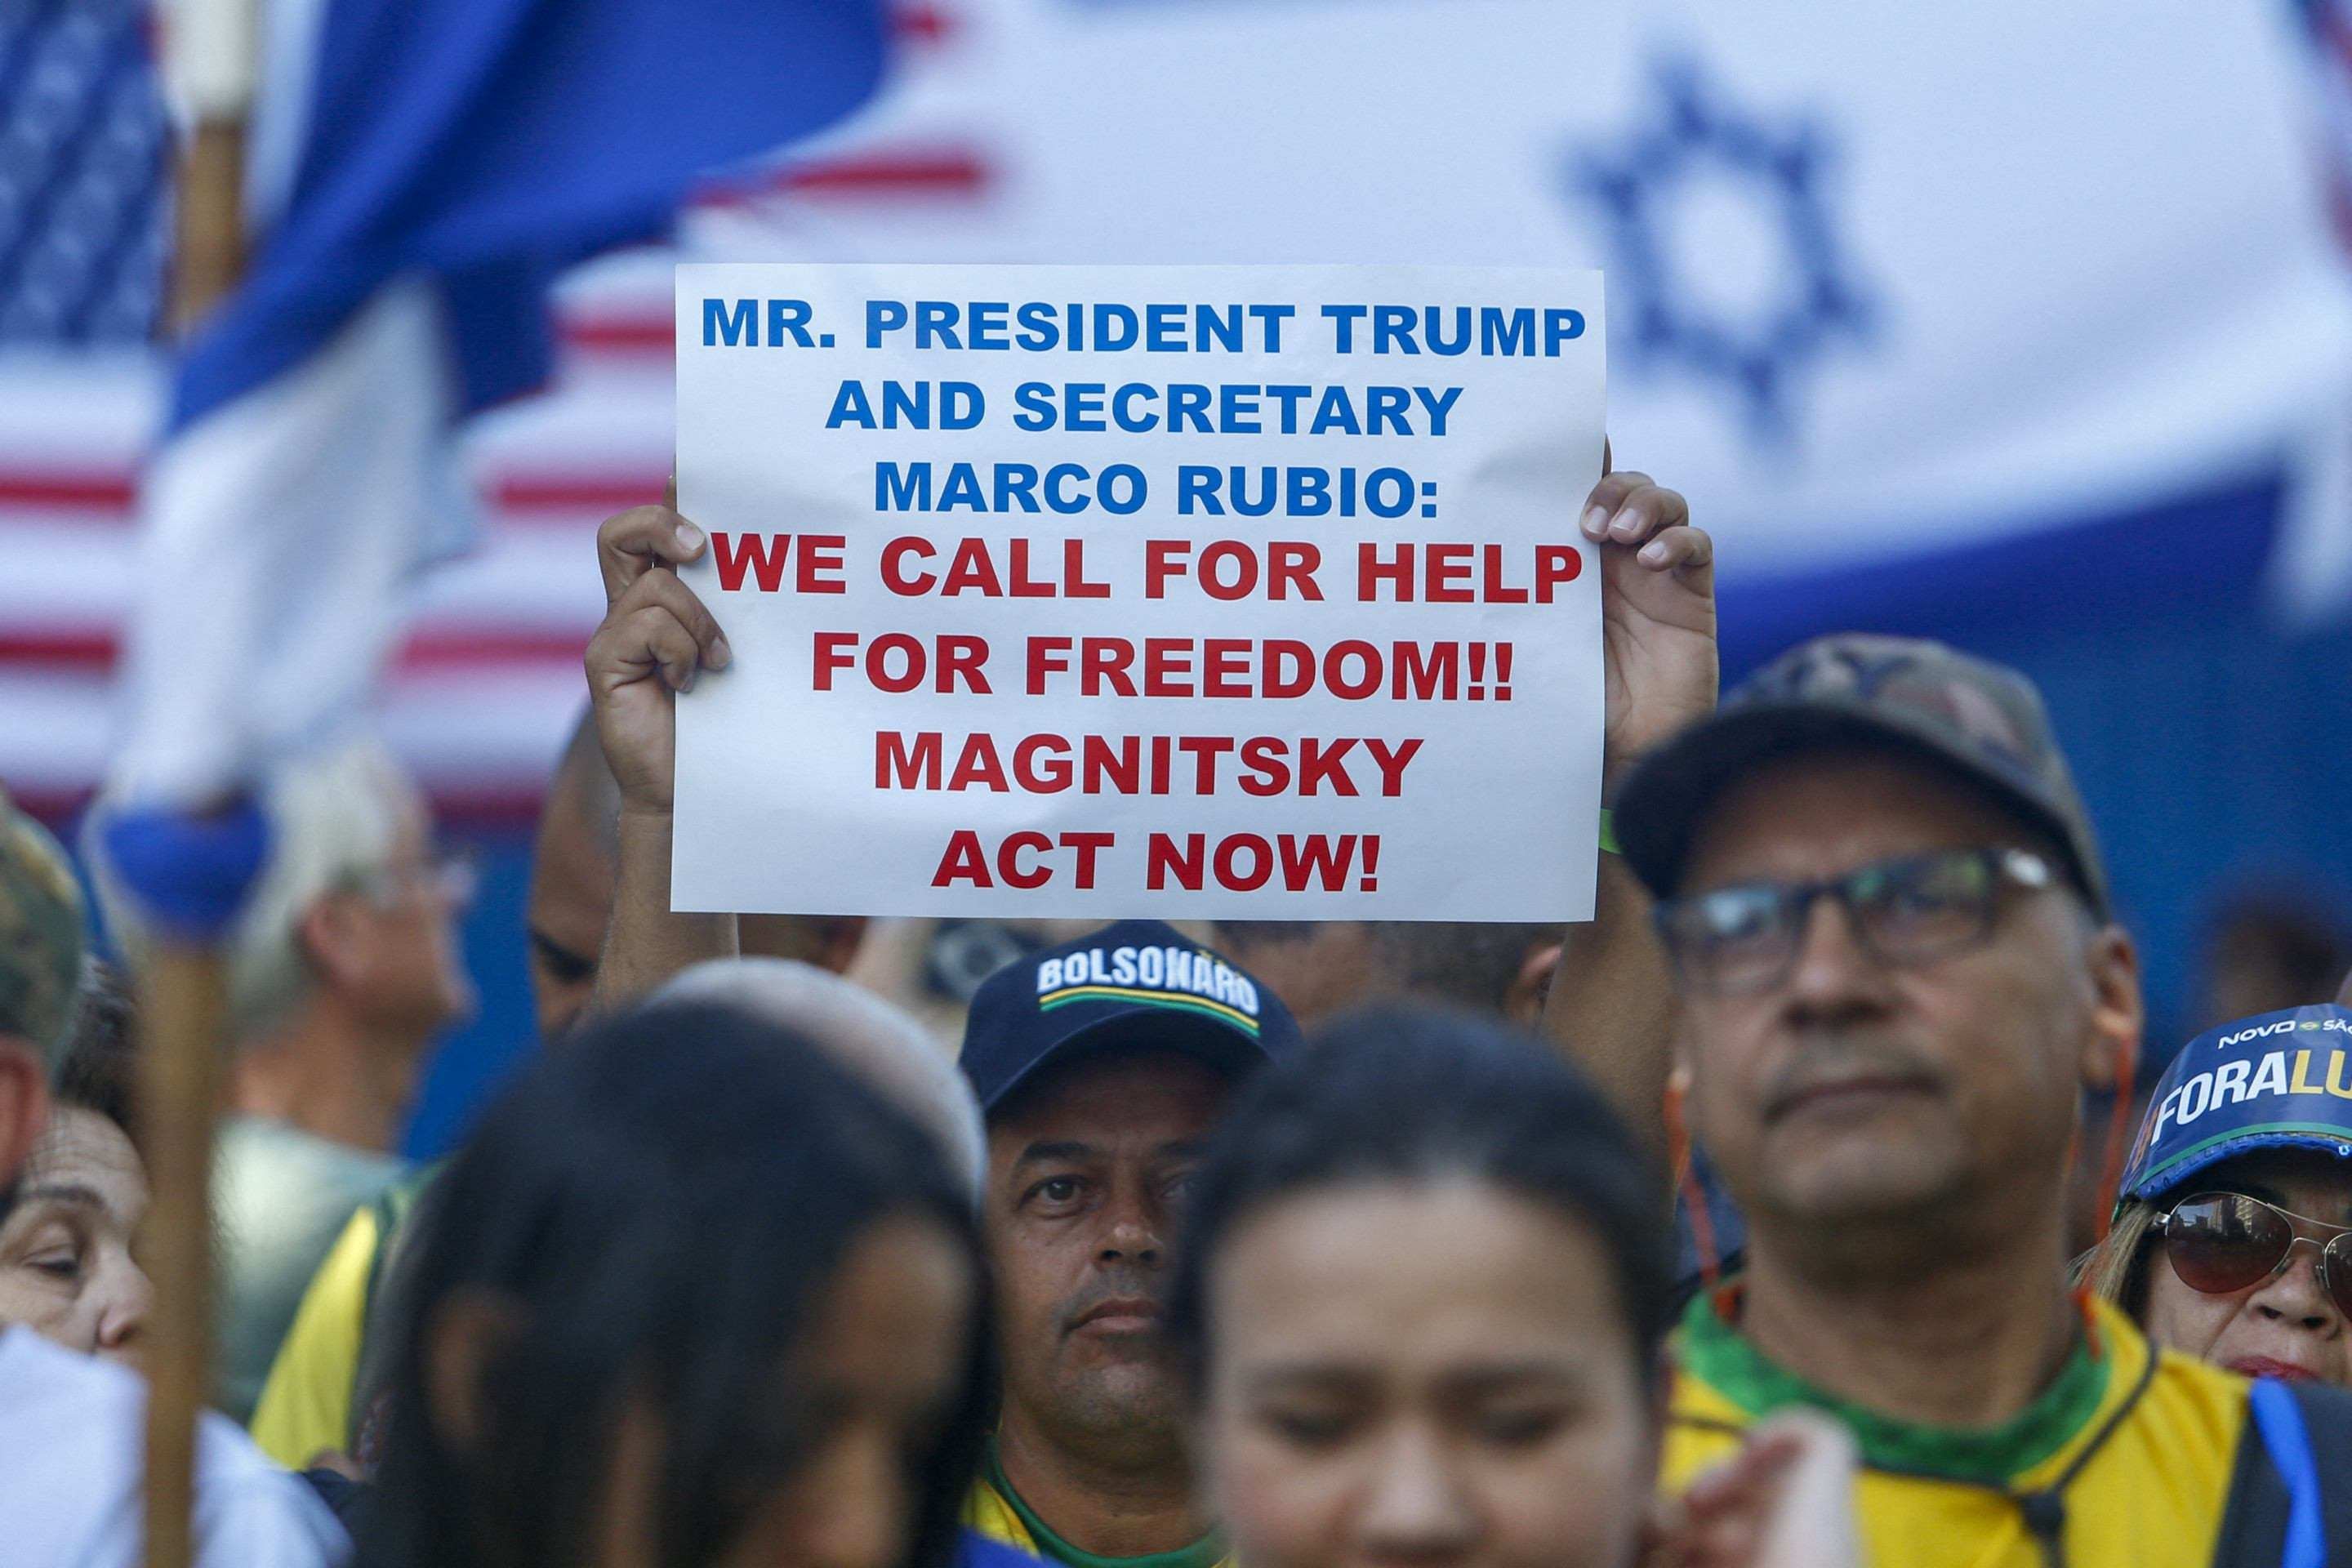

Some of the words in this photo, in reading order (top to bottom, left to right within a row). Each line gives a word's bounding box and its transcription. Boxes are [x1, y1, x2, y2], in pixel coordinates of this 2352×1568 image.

[702, 298, 835, 348] MR.
[866, 300, 1296, 354] PRESIDENT
[1321, 305, 1586, 358] TRUMP
[825, 380, 986, 430] AND
[1013, 381, 1463, 437] SECRETARY
[875, 461, 1147, 515] MARCO
[1178, 465, 1437, 519] RUBIO:
[710, 532, 846, 594] WE
[880, 537, 1111, 598] CALL
[1146, 540, 1325, 601] FOR
[1358, 543, 1583, 604] HELP
[813, 632, 992, 694] FOR
[1027, 636, 1512, 701] FREEDOM!!
[875, 731, 1423, 797] MAGNITSKY
[932, 831, 1115, 889] ACT
[1147, 833, 1380, 892] NOW!
[1036, 945, 1260, 1016] BOLSONARO
[2217, 1019, 2296, 1050] NOVO
